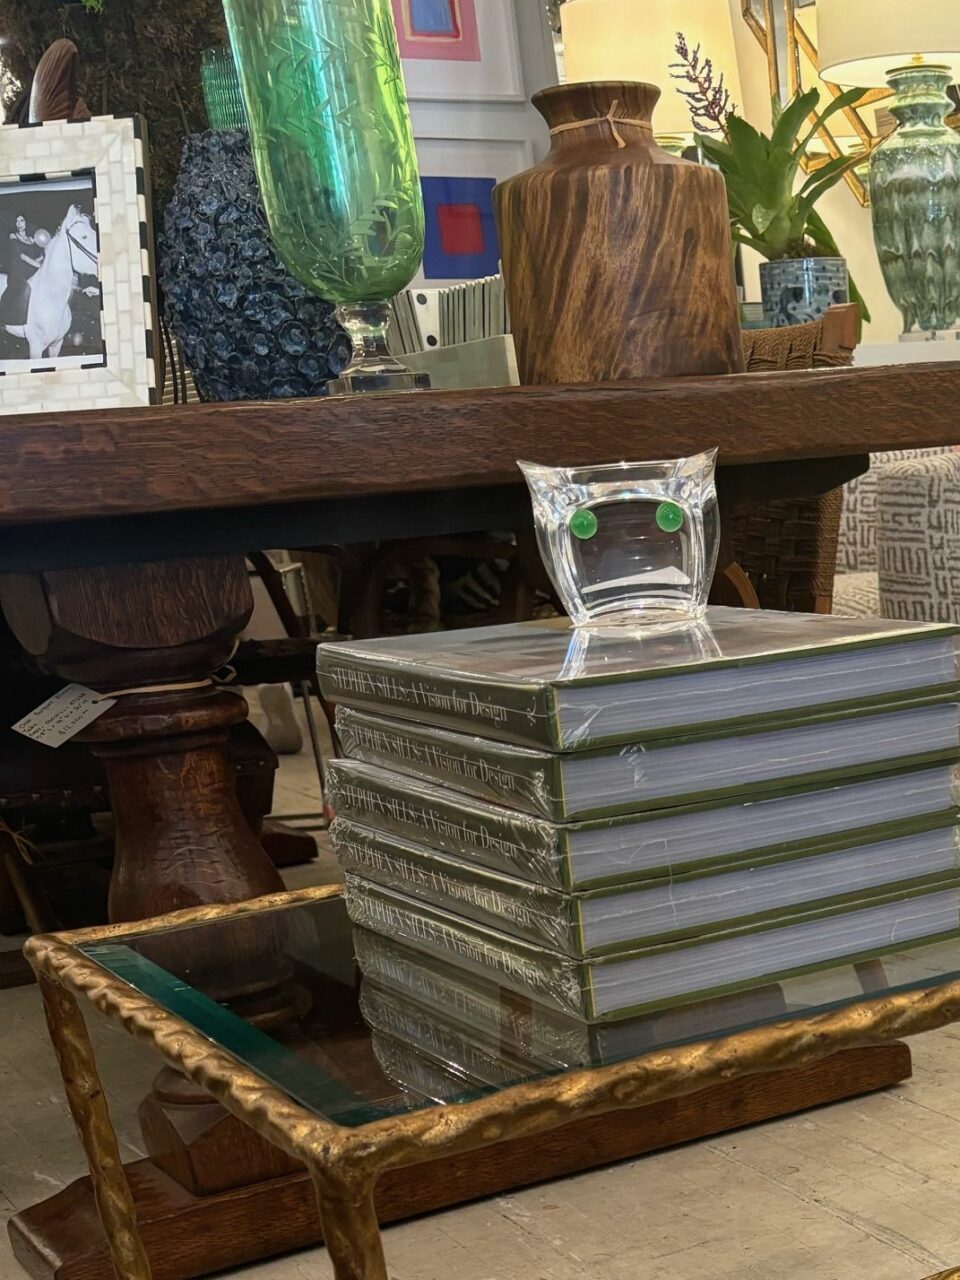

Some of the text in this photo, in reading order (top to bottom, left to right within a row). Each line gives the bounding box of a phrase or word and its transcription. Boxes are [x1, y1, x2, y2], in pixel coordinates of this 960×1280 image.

[332, 668, 508, 728] STEPHEN SILLS: A Vision for Design
[348, 724, 391, 753] STEPHEN
[431, 745, 462, 774] Vision
[463, 753, 477, 779] for
[480, 758, 515, 796] Design
[340, 784, 385, 815] STEPHEN
[429, 809, 460, 840] Vision
[462, 819, 477, 846] for
[480, 825, 518, 861] Design
[439, 872, 472, 903] Vision
[473, 883, 489, 909] for
[491, 890, 530, 928] Design
[483, 943, 499, 969] for
